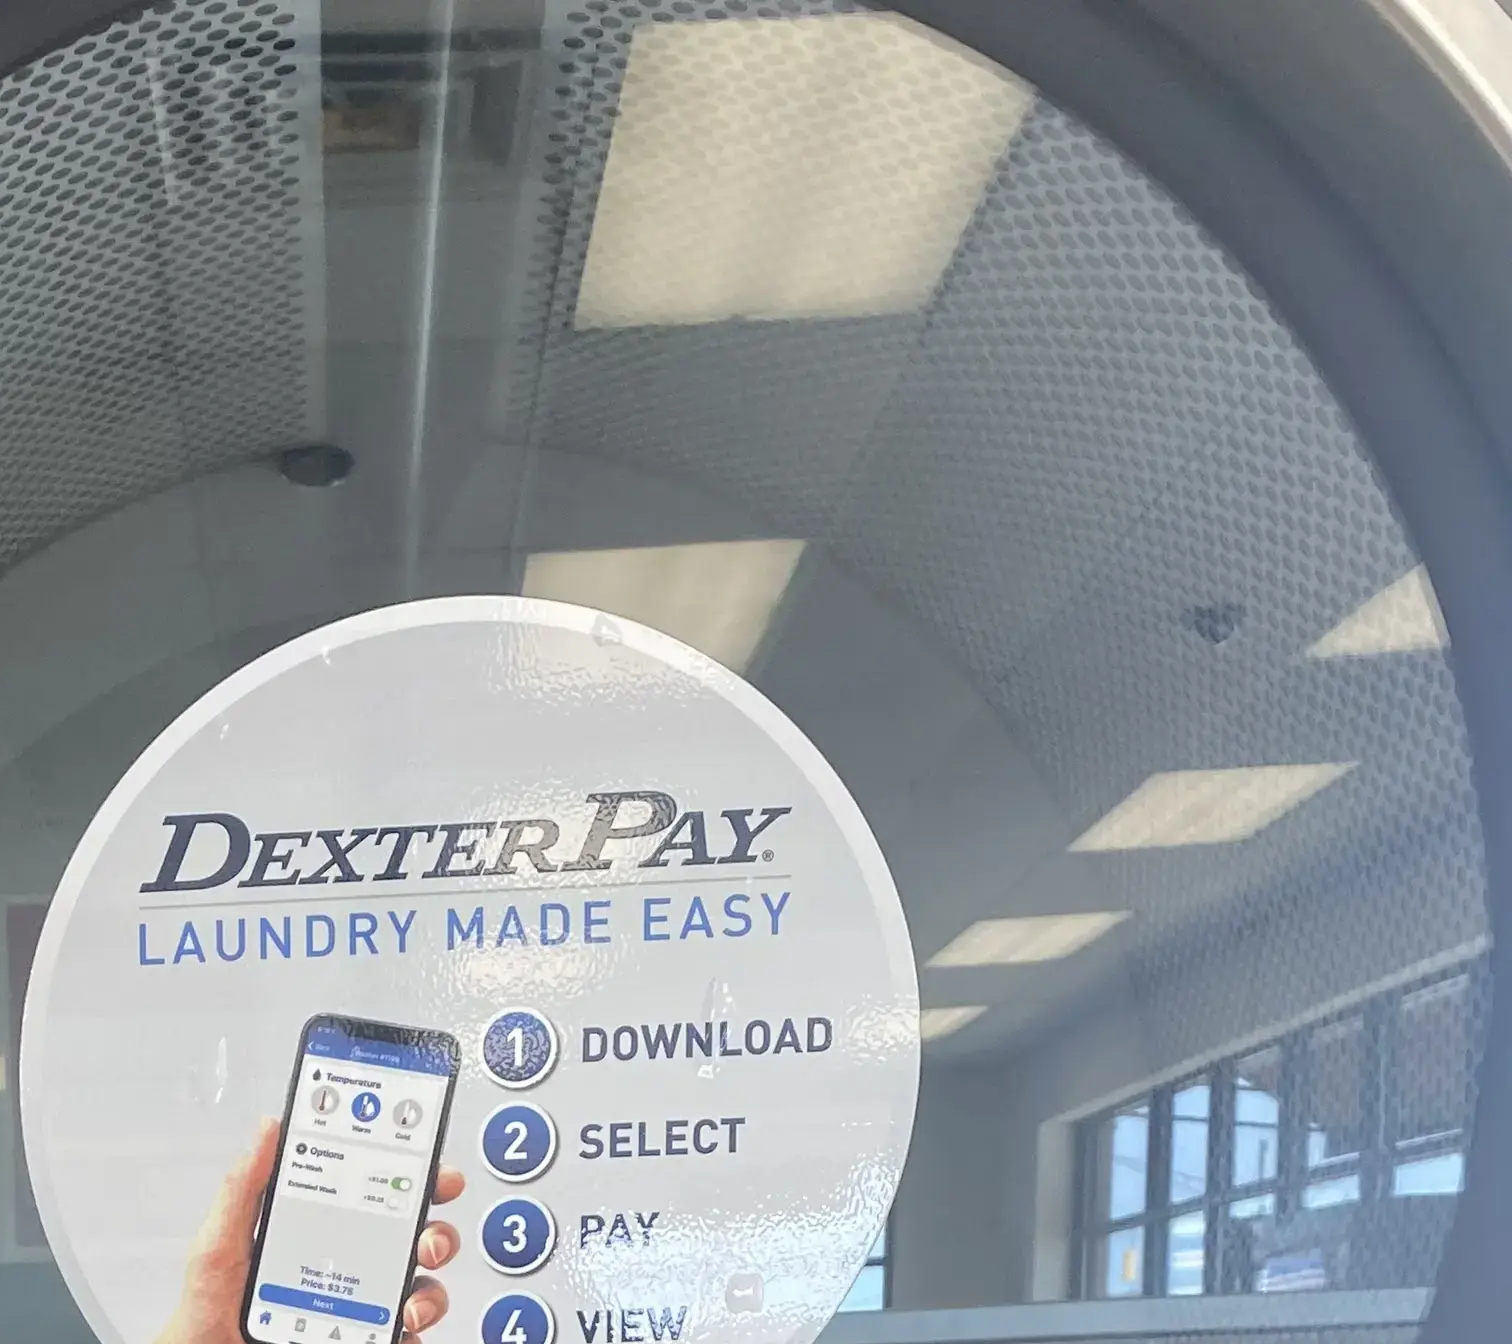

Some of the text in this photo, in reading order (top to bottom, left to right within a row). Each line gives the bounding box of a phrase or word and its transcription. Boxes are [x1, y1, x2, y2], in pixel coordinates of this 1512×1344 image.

[139, 892, 791, 965] LAUNDRY MADE EASY
[506, 1017, 833, 1068] 1 DOWNLOAD
[310, 1147, 345, 1161] Options
[503, 1117, 746, 1161] 2 SELECT
[502, 1212, 660, 1254] 3 PAY
[313, 1298, 334, 1311] Next
[576, 1306, 688, 1344] VIEW
